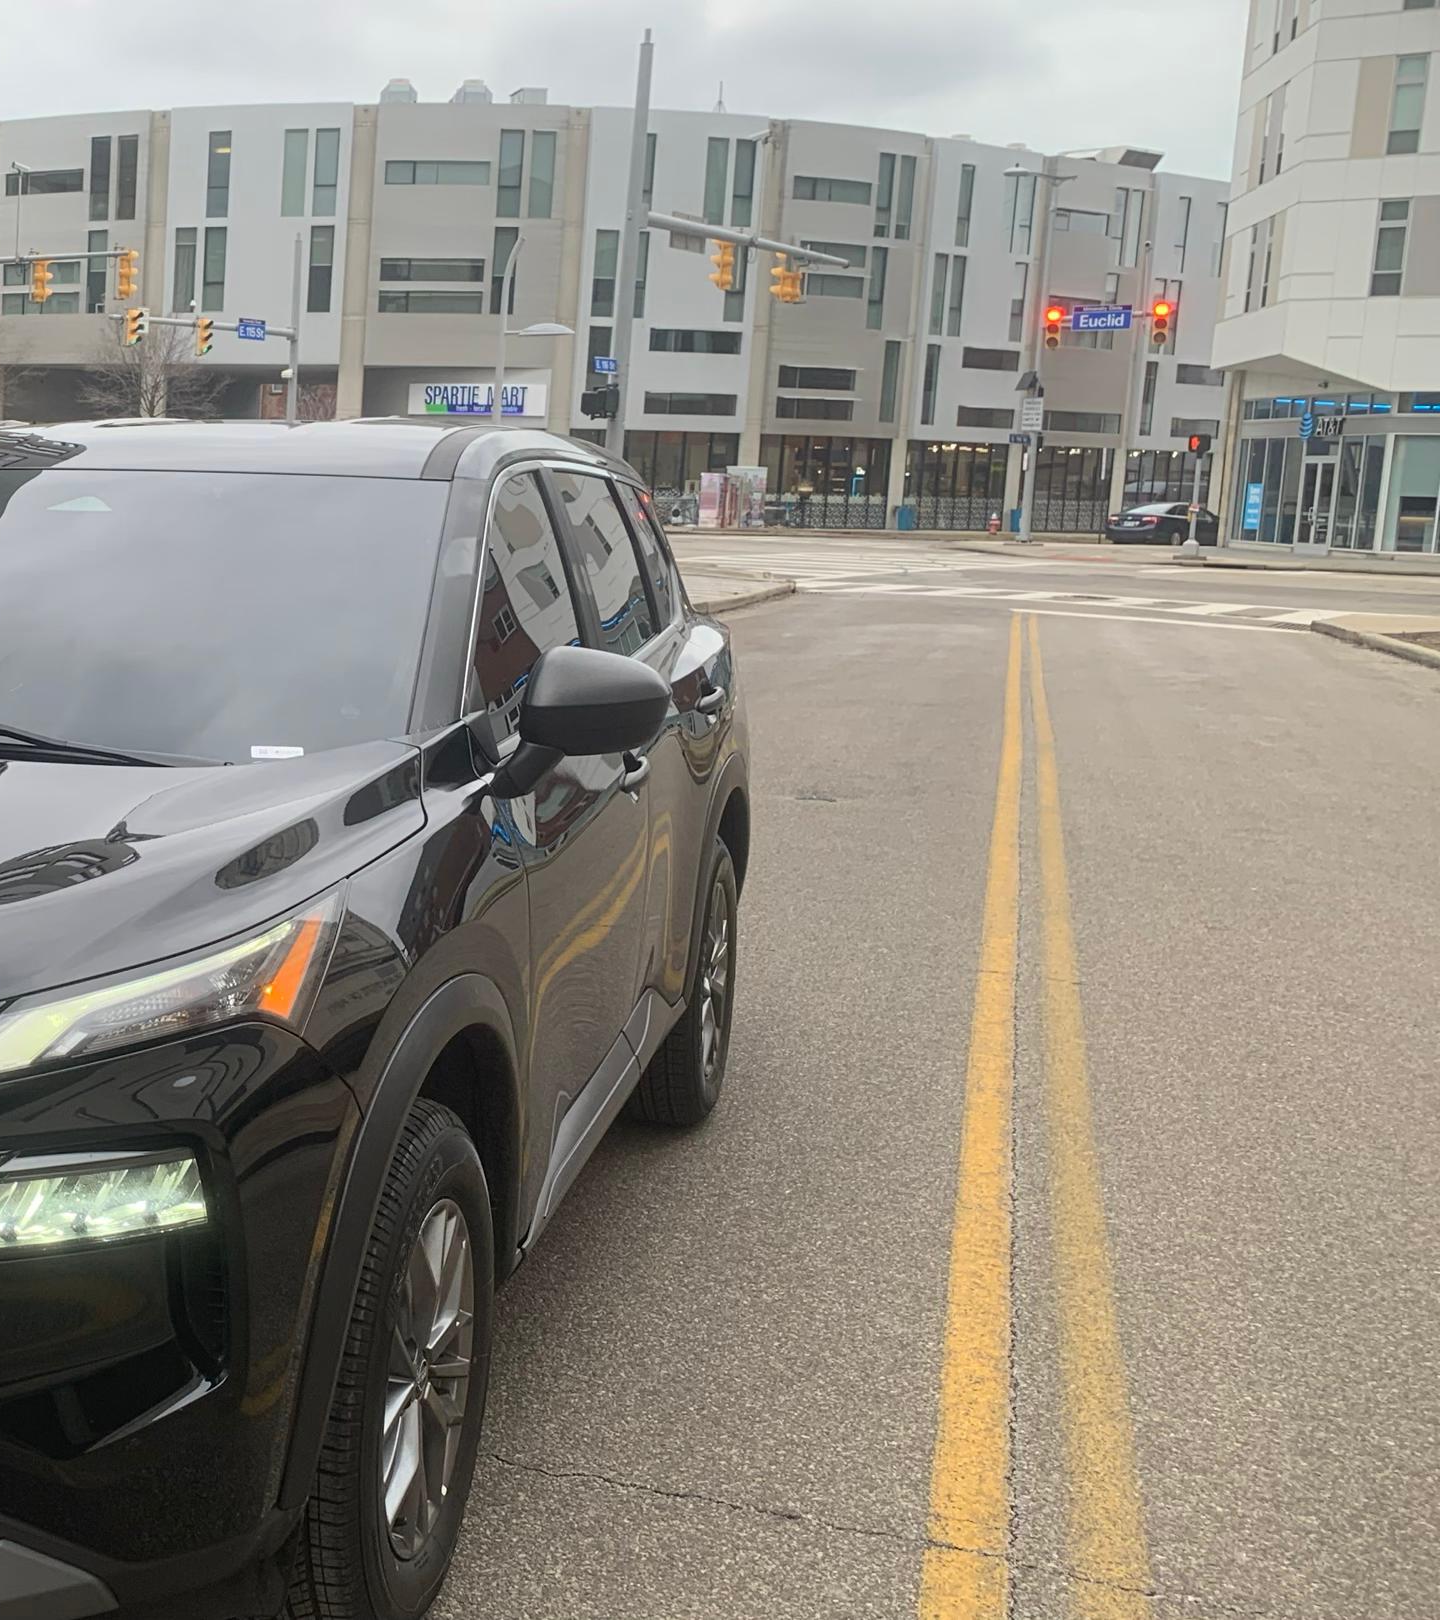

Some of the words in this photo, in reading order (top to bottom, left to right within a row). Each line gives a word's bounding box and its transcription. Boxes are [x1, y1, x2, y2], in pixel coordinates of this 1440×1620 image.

[1080, 313, 1125, 328] Euclid
[256, 327, 264, 339] St
[424, 385, 480, 406] SPARTIE
[1316, 416, 1344, 437] AT&T
